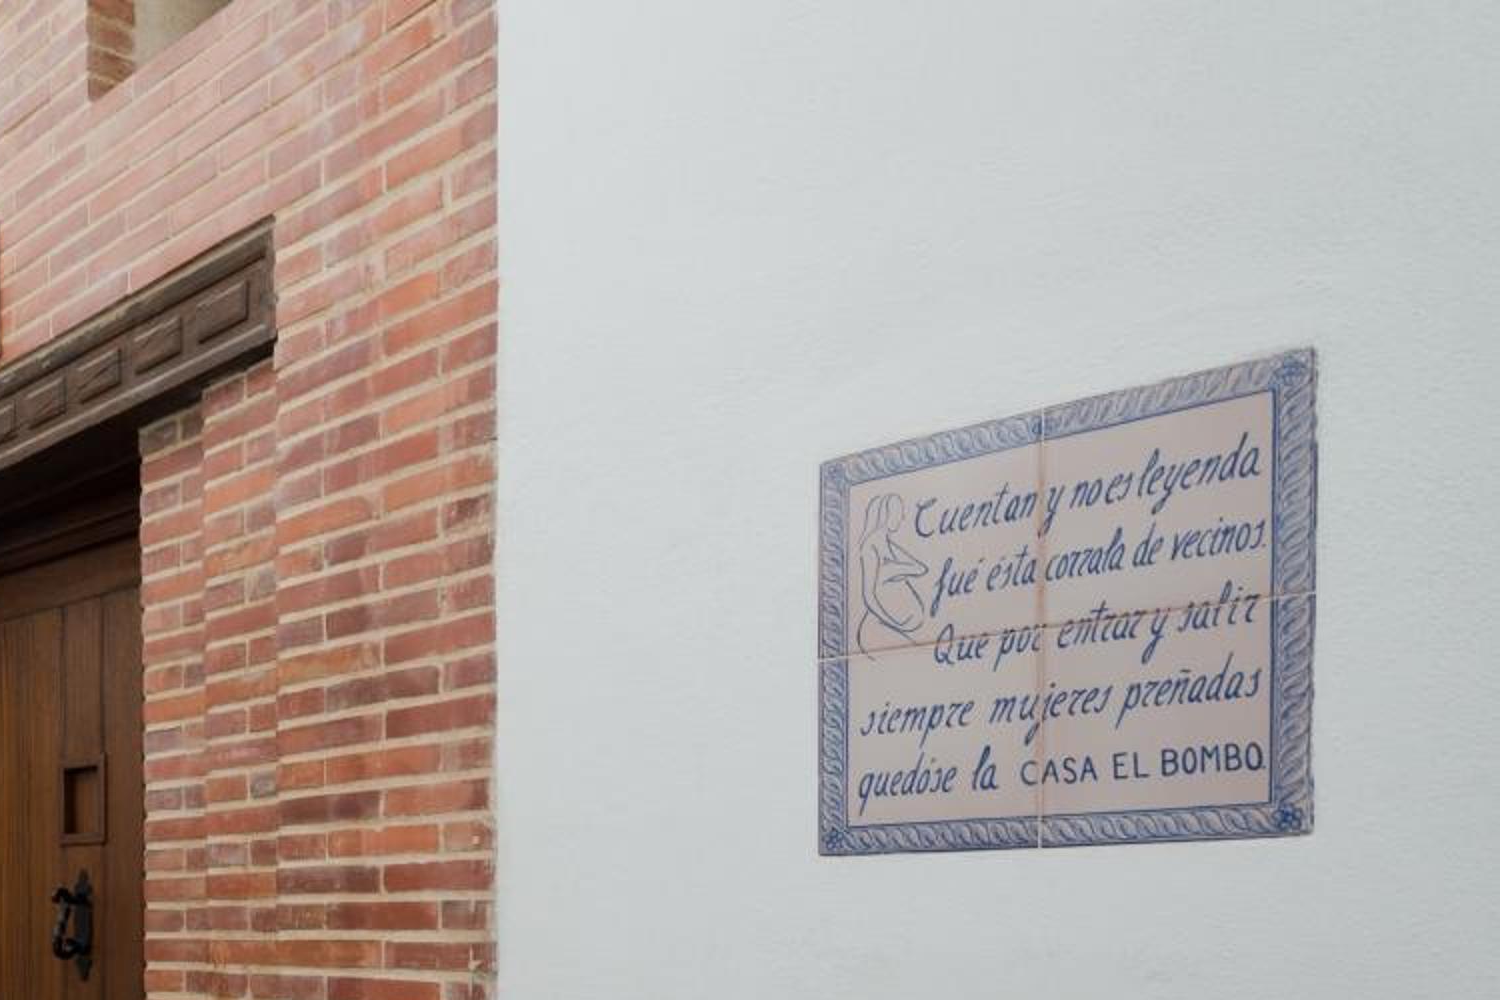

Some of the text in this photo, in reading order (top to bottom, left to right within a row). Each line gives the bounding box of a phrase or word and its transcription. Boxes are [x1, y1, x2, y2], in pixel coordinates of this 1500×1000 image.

[914, 481, 1038, 538] Cuentan
[1037, 485, 1066, 539] y
[1137, 431, 1261, 515] leyenda
[1045, 526, 1126, 583] corrala
[1131, 521, 1165, 568] de
[933, 580, 1261, 672] Que por entrar y salir
[860, 651, 1263, 749] siempre mujeres preñadas
[971, 745, 998, 791] la
[1019, 756, 1098, 786] CASA
[1112, 752, 1149, 780] EL
